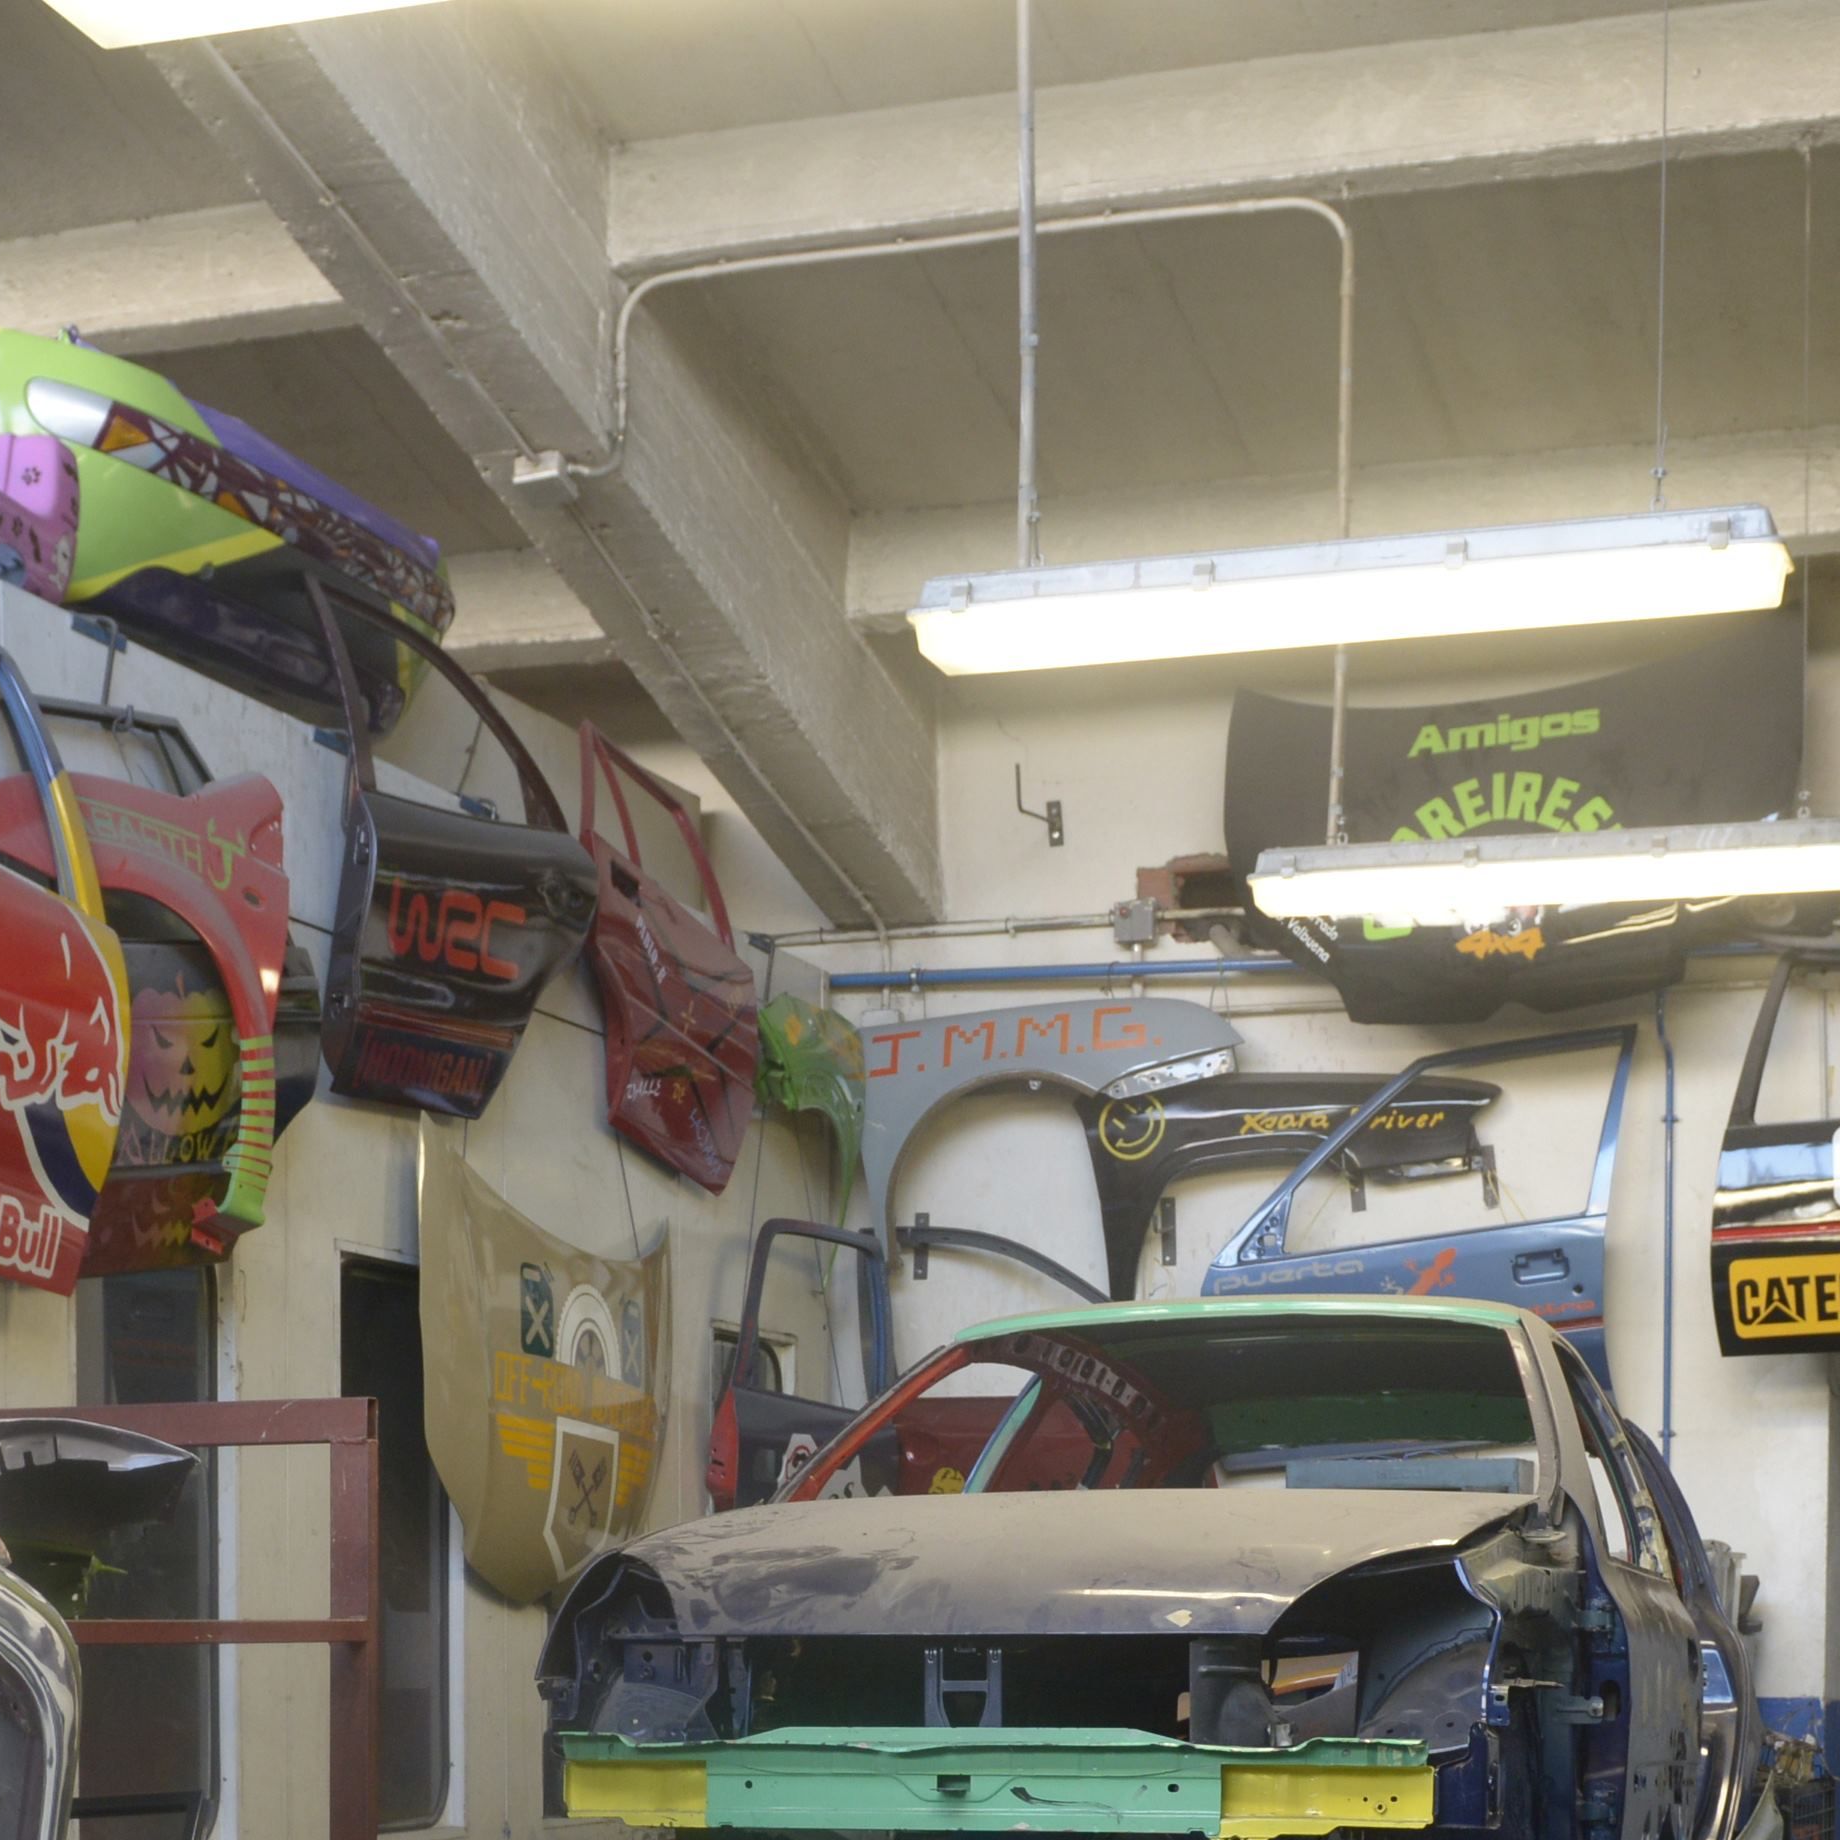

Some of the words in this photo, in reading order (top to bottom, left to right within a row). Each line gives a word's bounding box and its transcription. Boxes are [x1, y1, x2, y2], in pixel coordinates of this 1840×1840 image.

[1408, 707, 1600, 759] Amigos
[1287, 918, 1331, 964] Valbuena
[1213, 1259, 1365, 1294] puerta
